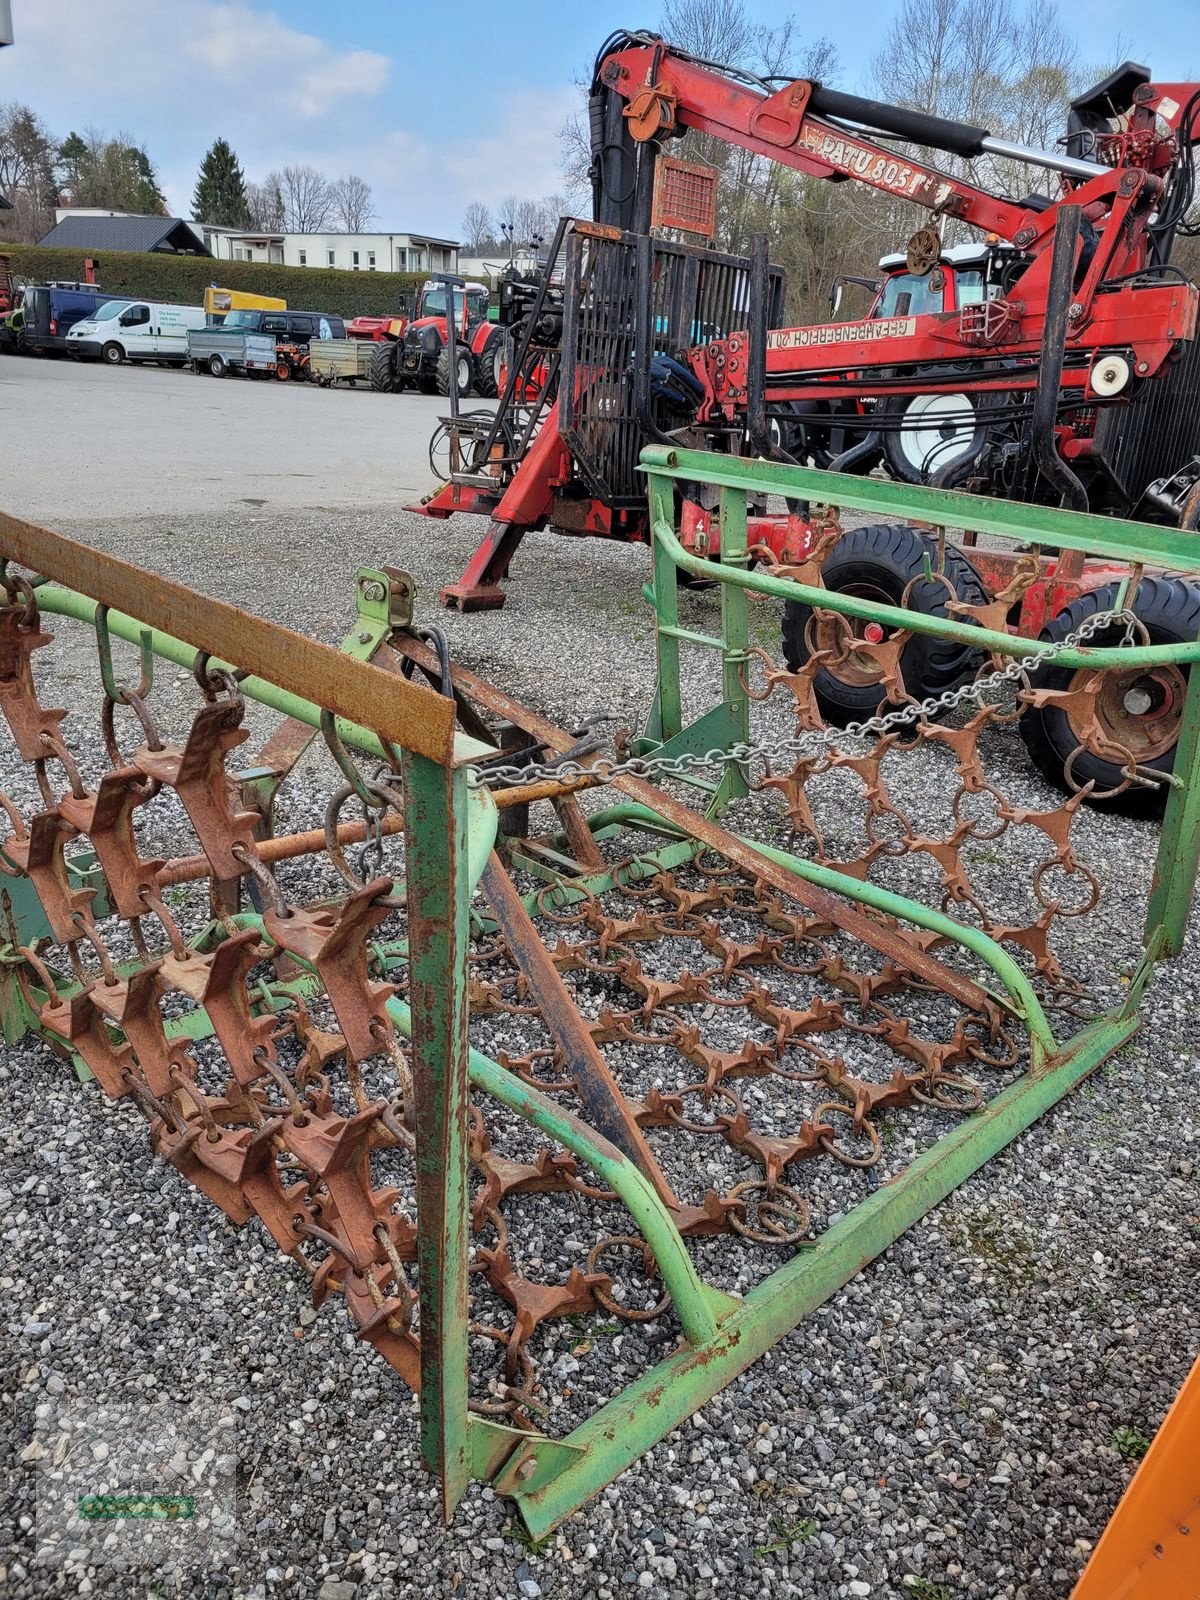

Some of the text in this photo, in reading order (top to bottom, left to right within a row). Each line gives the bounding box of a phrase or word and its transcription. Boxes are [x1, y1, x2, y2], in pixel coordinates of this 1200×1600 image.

[821, 136, 912, 187] PATU 805
[696, 519, 704, 531] 4
[804, 530, 812, 548] 3
